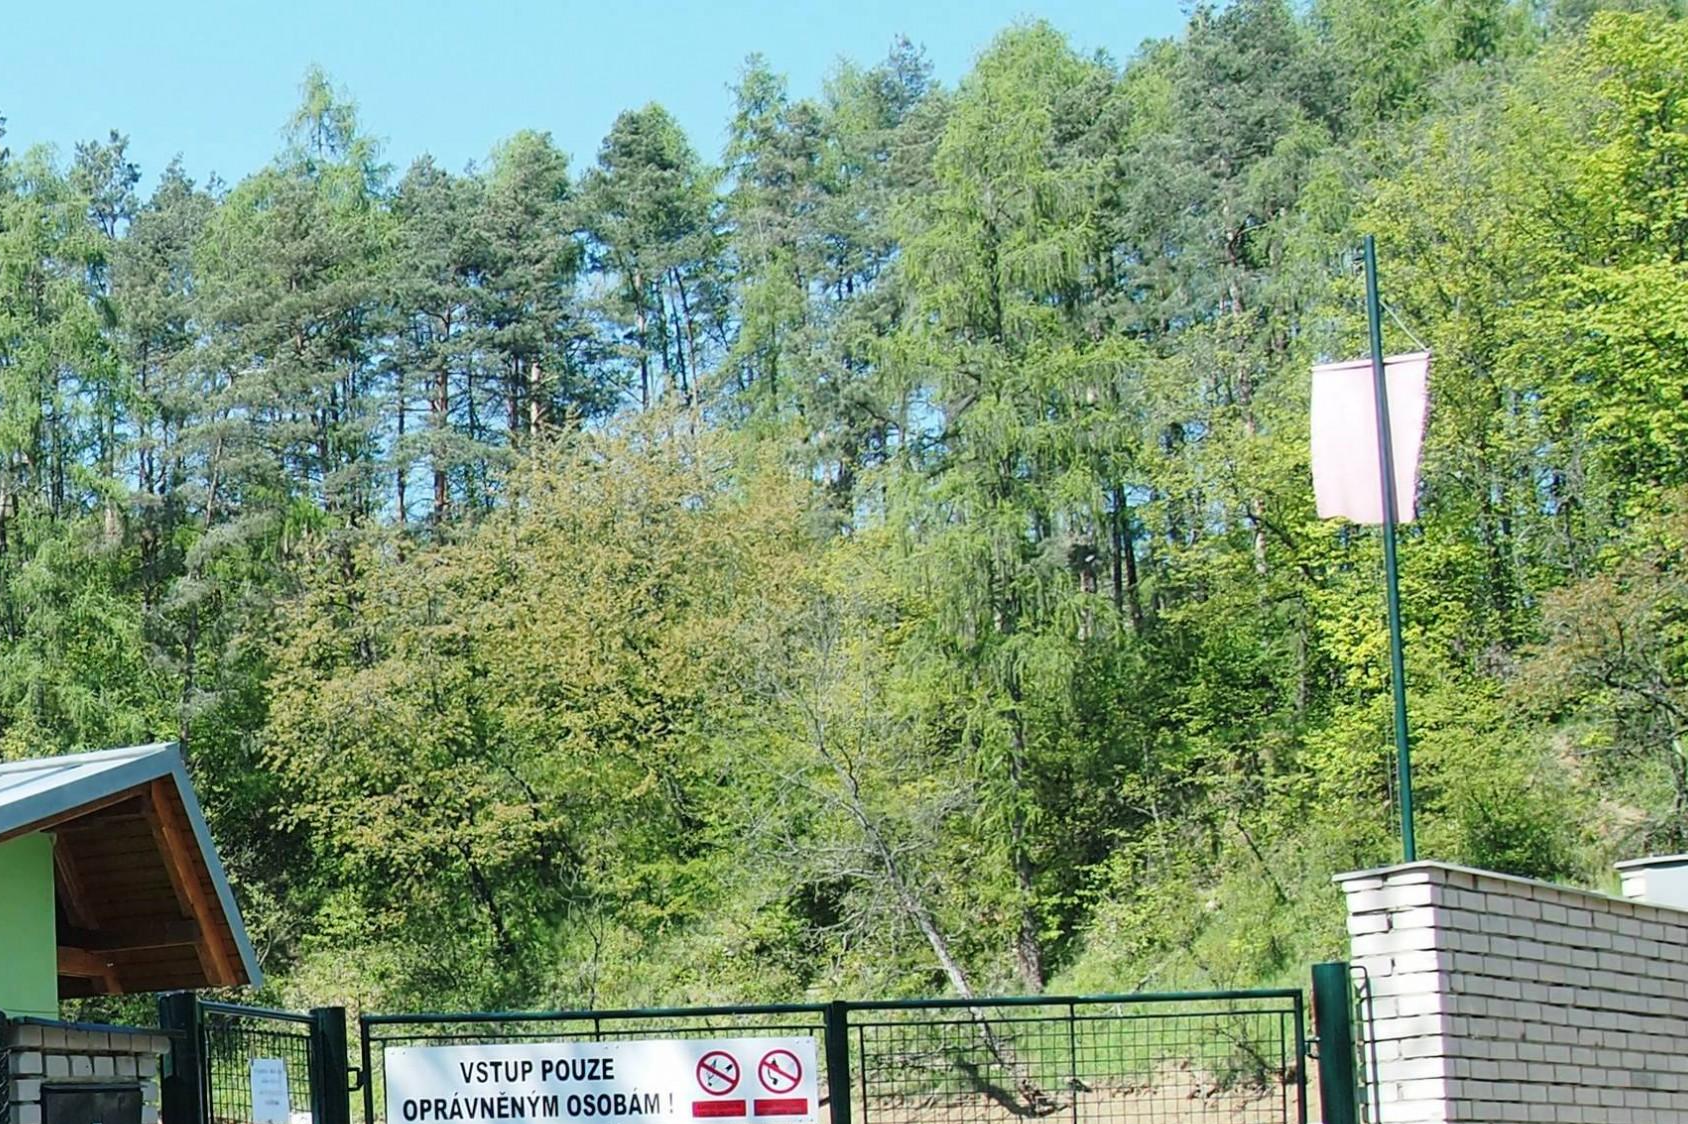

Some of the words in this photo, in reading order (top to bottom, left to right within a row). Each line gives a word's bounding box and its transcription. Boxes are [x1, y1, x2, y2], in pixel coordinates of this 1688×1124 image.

[460, 1061, 533, 1083] VSTUP
[541, 1058, 614, 1081] POUZE
[403, 1091, 559, 1121] OPRÁVNĚNÝM
[567, 1088, 660, 1117] OSOBÁM
